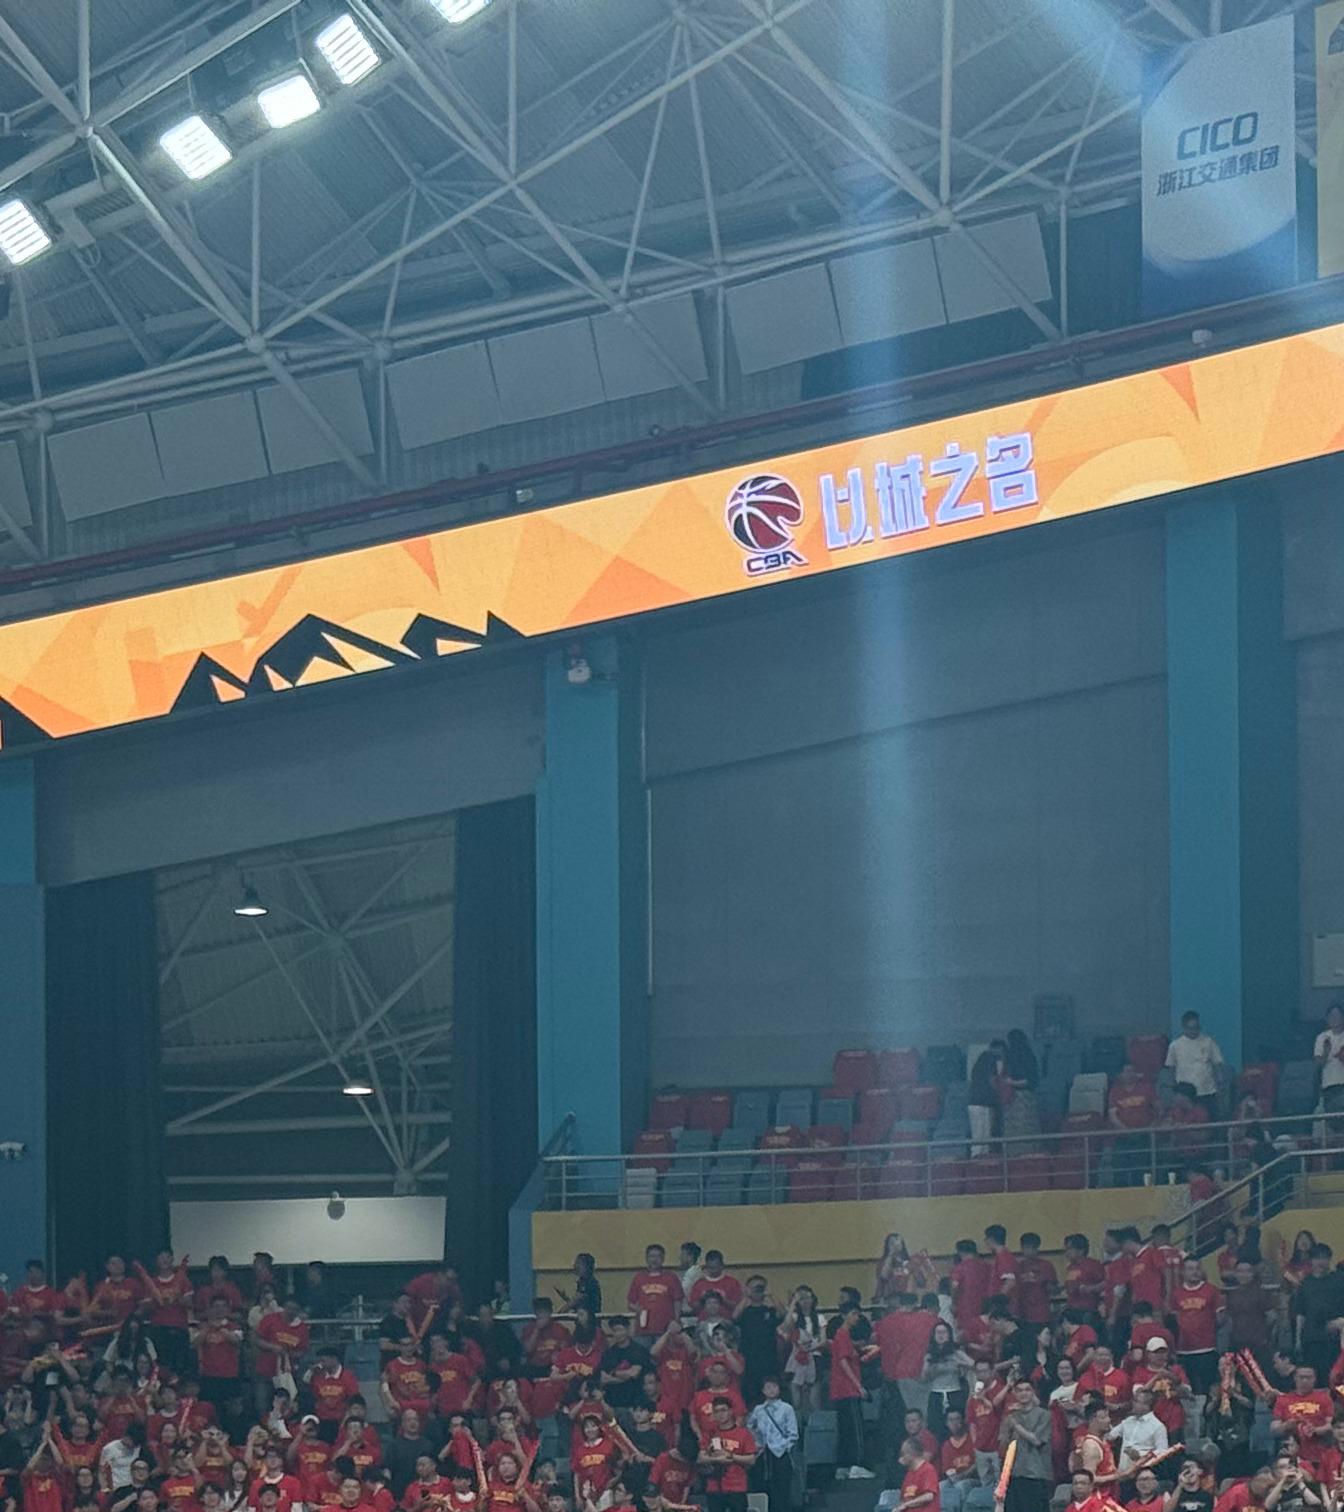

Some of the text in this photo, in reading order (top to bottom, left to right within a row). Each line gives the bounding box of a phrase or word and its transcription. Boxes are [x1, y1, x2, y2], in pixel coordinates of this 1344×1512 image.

[1176, 112, 1258, 160] CICO
[1156, 144, 1279, 196] 浙江交通集团
[819, 431, 1039, 551] 以城之名
[746, 551, 808, 575] CBA
